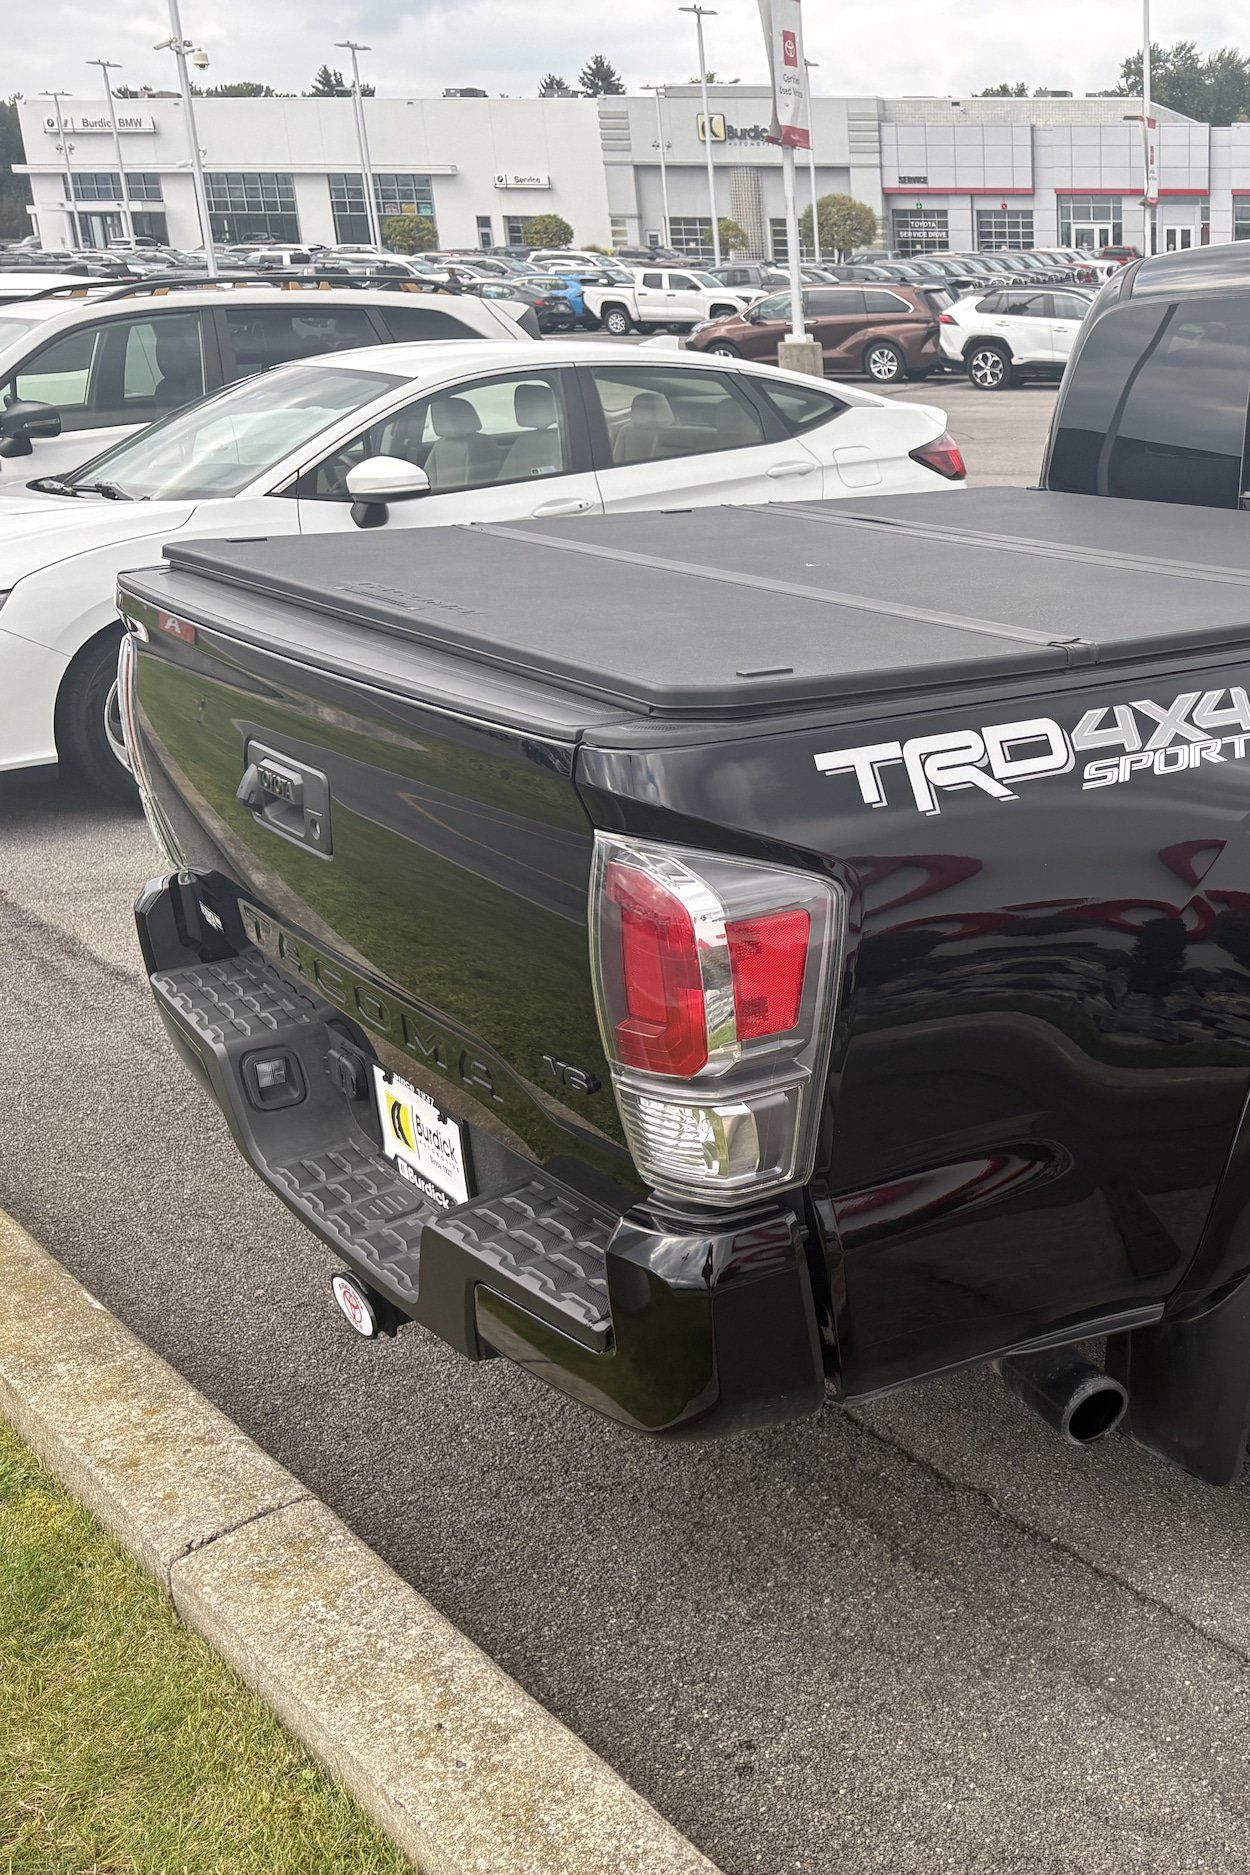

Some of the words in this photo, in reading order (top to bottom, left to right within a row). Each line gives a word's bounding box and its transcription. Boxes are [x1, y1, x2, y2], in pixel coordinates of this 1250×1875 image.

[82, 118, 113, 128] Burdic
[117, 118, 142, 128] BMW
[726, 124, 769, 140] Burdic
[898, 175, 928, 185] SERVICE
[257, 766, 295, 801] TOYOTA
[813, 717, 1077, 817] TRD
[243, 903, 504, 1103] TACOMA
[415, 1113, 458, 1164] Burdick
[408, 1168, 450, 1210] Burdick
